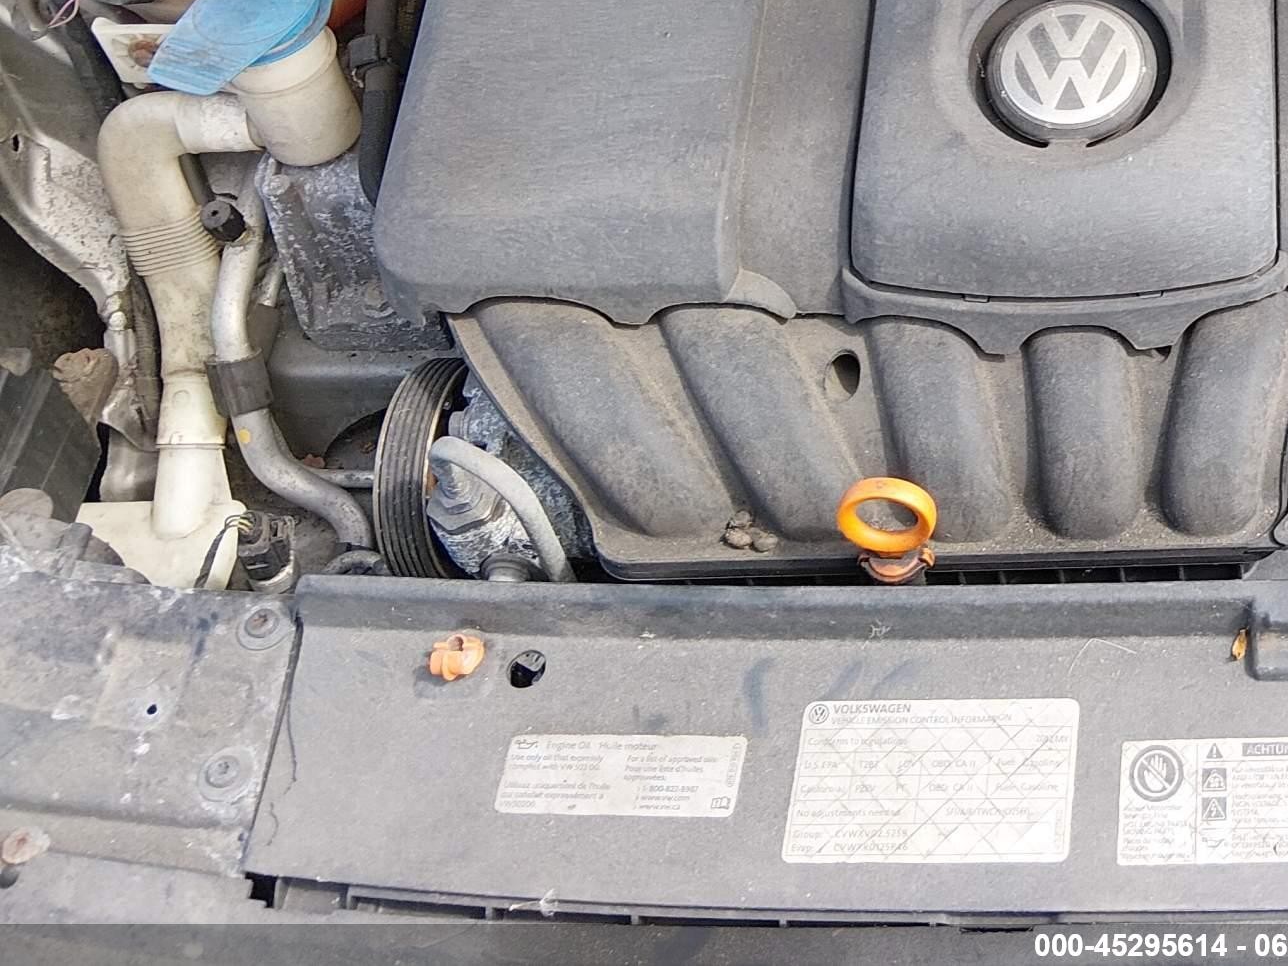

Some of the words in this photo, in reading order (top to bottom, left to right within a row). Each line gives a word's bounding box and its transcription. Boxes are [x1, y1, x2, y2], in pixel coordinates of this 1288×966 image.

[832, 704, 911, 714] VOLKSWAGEN
[547, 740, 576, 753] Engine
[579, 741, 591, 750] Oil
